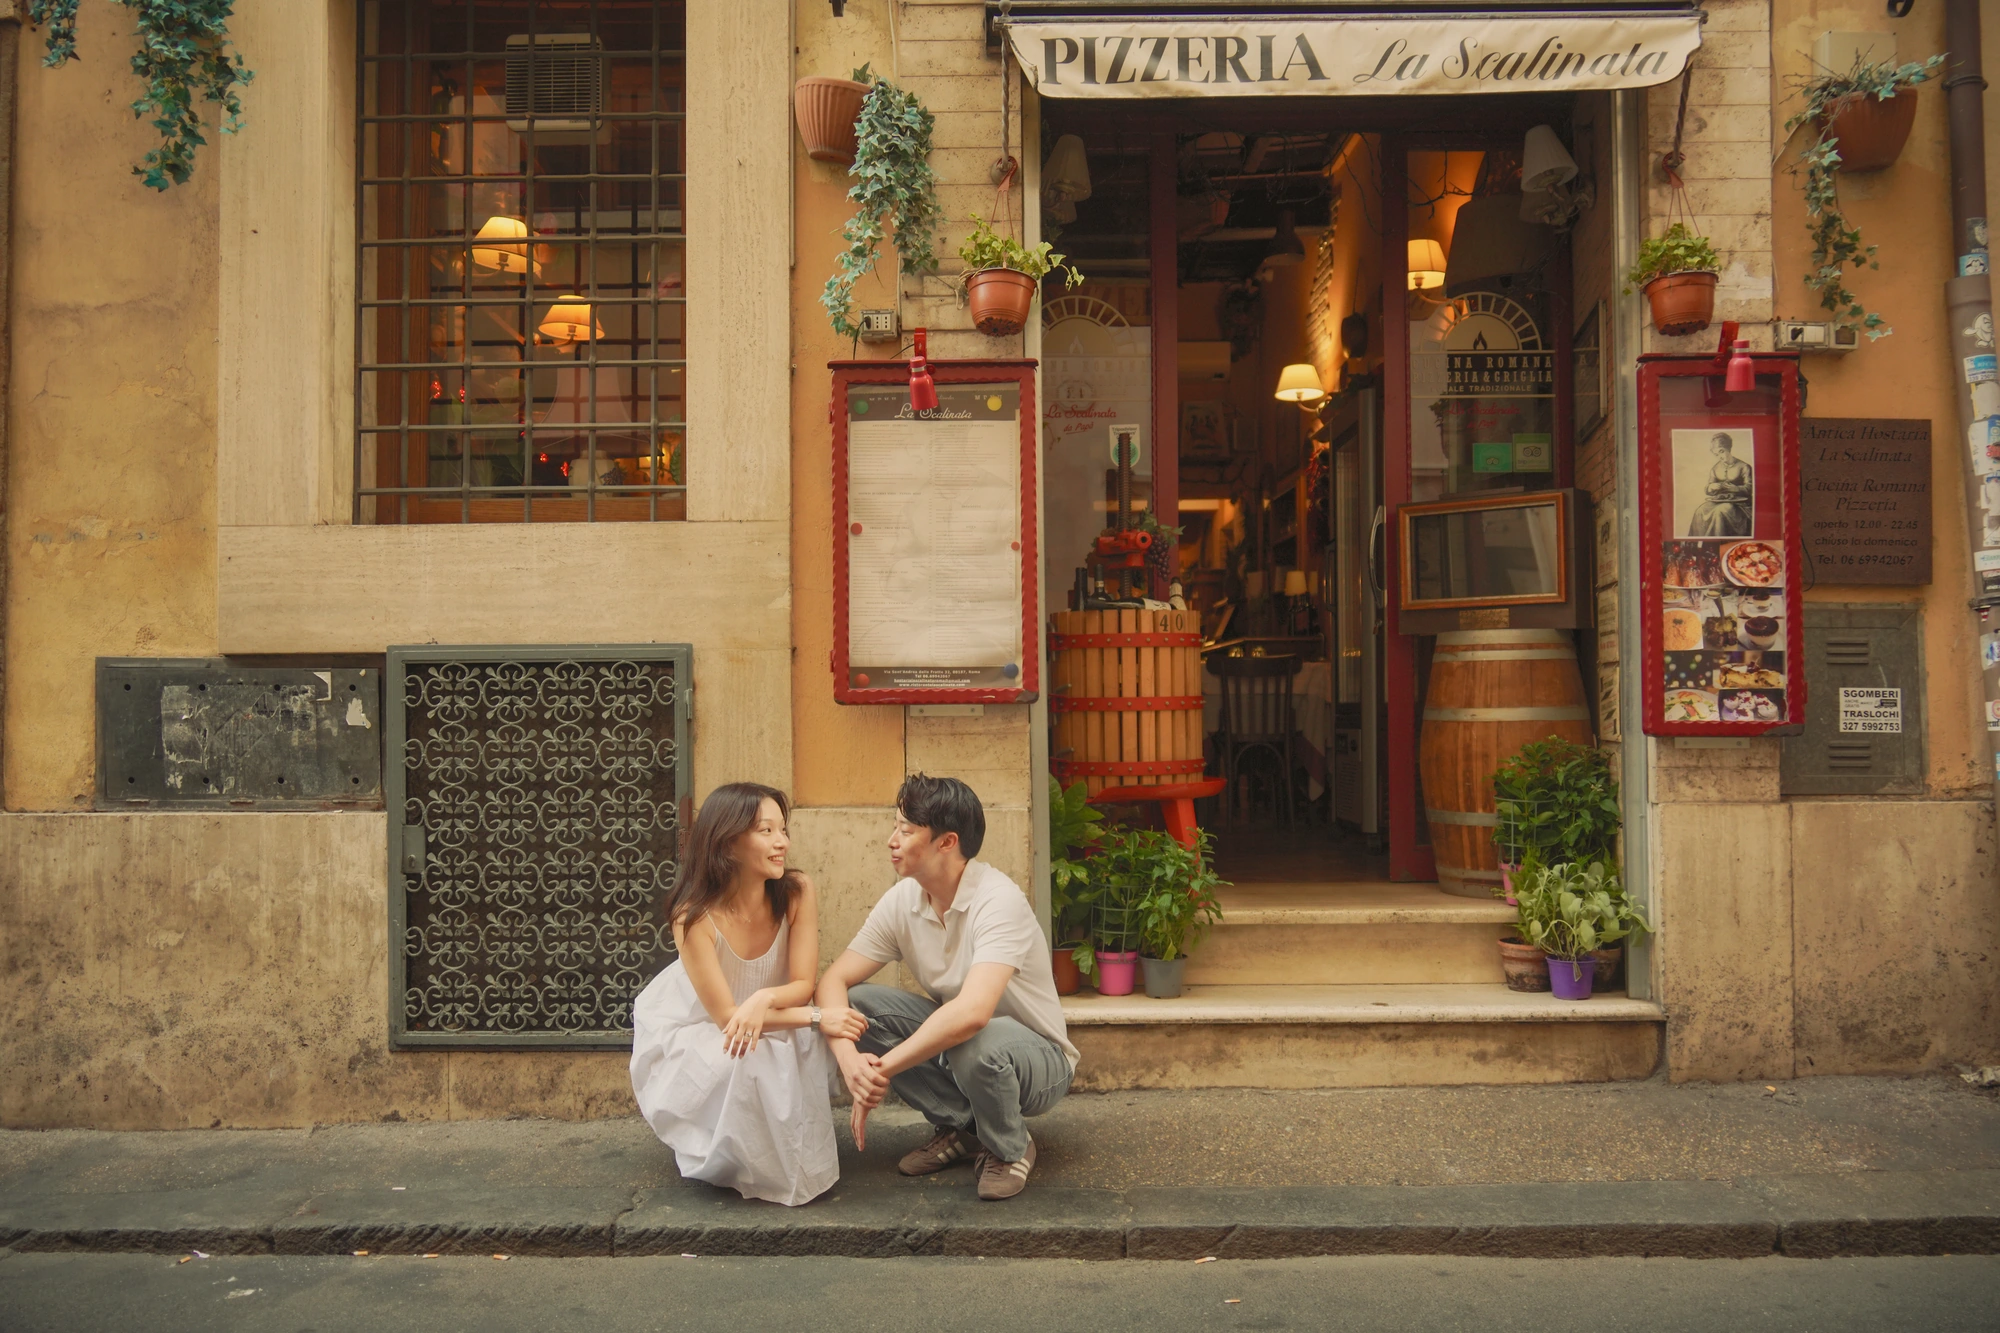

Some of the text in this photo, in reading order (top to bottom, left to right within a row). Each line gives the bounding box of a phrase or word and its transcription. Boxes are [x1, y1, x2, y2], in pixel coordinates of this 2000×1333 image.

[1039, 33, 1670, 86] PIZZERIA La Scalinata
[1486, 356, 1552, 368] ROMANA
[1469, 384, 1532, 392] TRADIZIONALE
[894, 402, 973, 419] La Scalinata
[1043, 404, 1117, 419] La Scalinata
[1063, 423, 1073, 432] da
[1804, 425, 1928, 441] Antica Hostaria
[1819, 447, 1912, 462] La Scalinata
[1805, 477, 1926, 493] Cucina Romana
[1835, 497, 1898, 511] Pizzeria
[1813, 520, 1849, 530] aperto
[1854, 520, 1882, 529] 12.00
[1891, 520, 1919, 530] 22.45
[1815, 536, 1918, 547] chiuso la domenica
[1817, 554, 1914, 565] Tel. 06 69942067
[1159, 613, 1184, 632] 40
[1843, 690, 1899, 698] SGOMBERI
[1843, 710, 1899, 718] TRASLOCHI
[1842, 722, 1900, 731] 327 5992753
